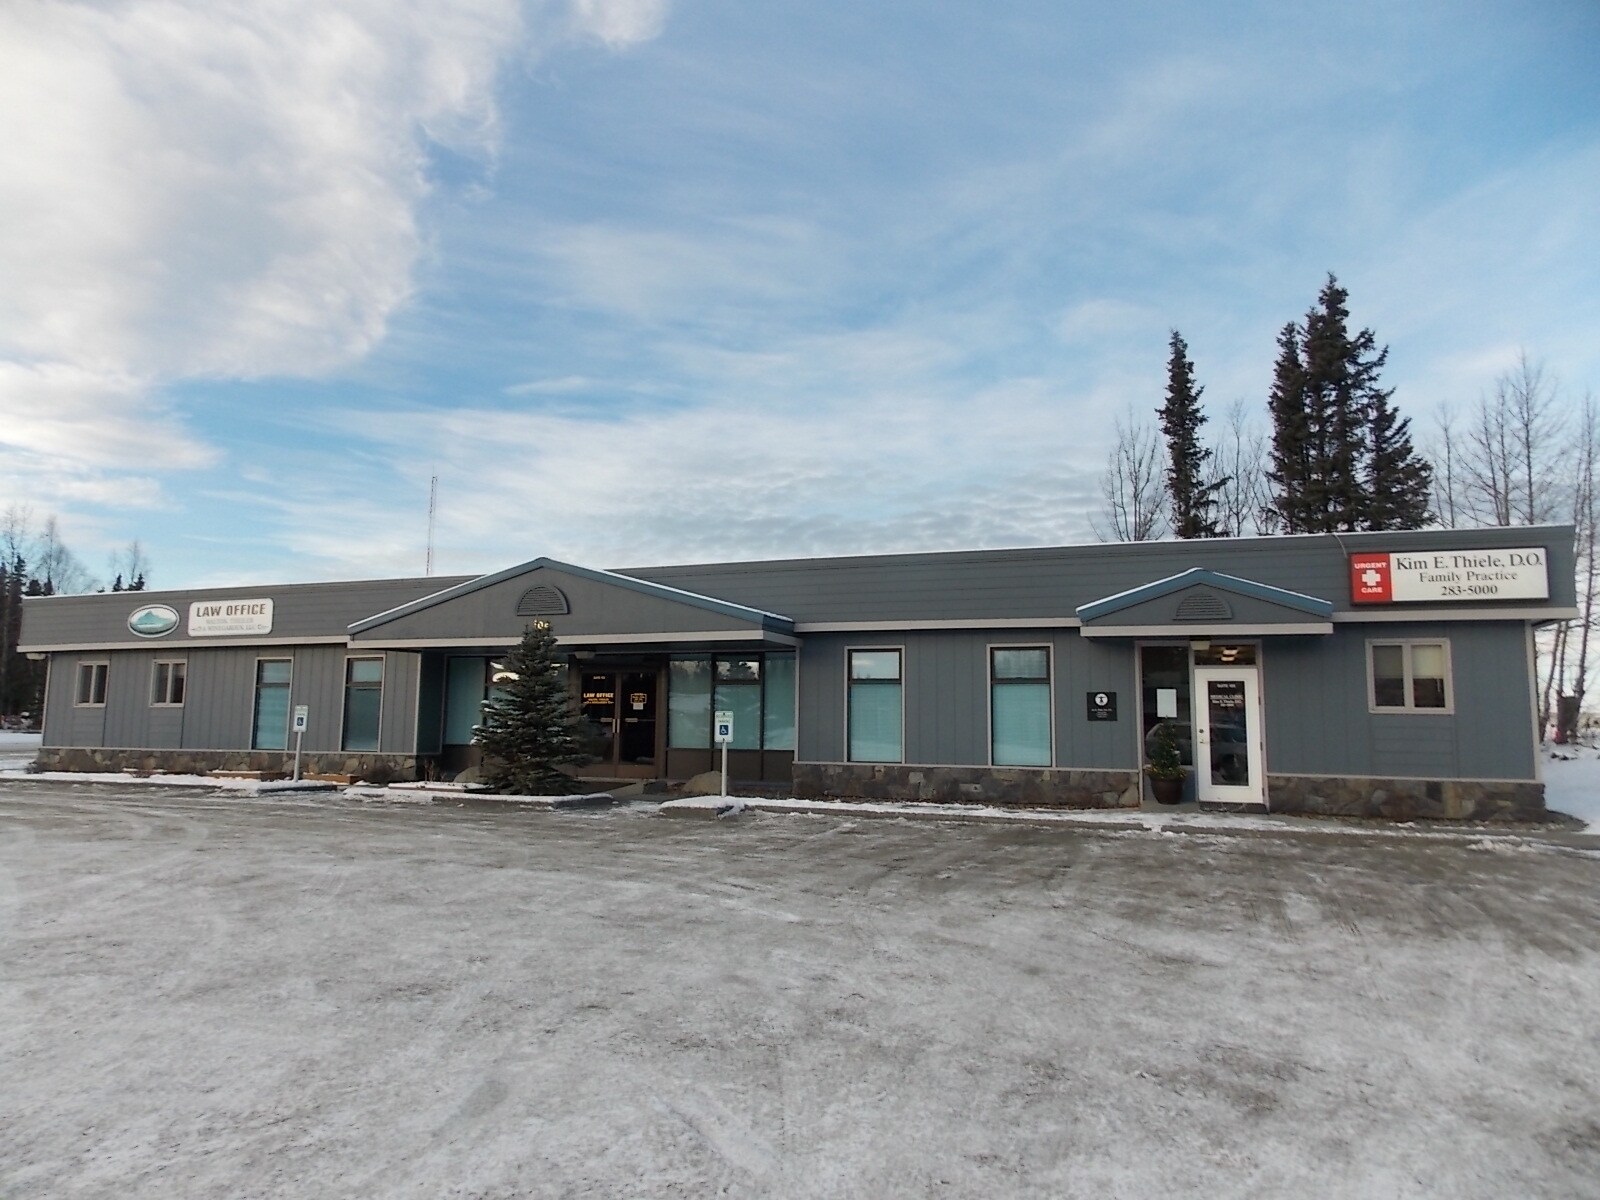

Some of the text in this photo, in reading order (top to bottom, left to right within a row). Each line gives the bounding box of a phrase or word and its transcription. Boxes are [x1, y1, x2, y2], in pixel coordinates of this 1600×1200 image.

[1396, 557, 1428, 570] Kim
[1509, 552, 1543, 567] D.O.
[1419, 570, 1518, 584] Family Practice
[1441, 585, 1498, 596] 283-5000
[196, 603, 266, 618] LAW OFFICE
